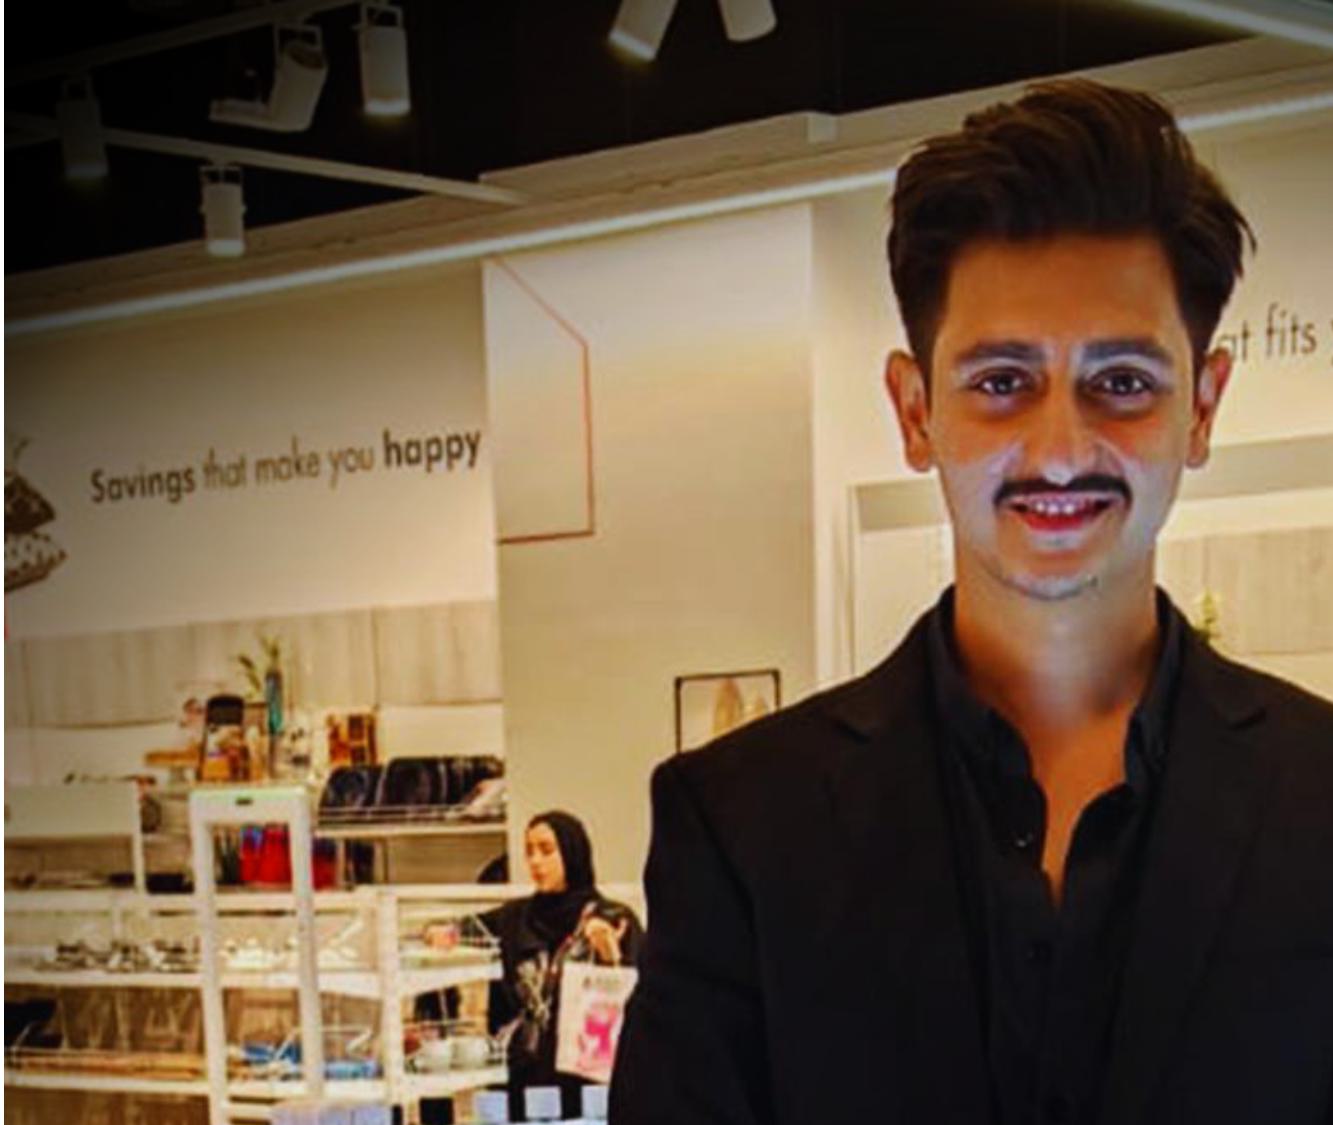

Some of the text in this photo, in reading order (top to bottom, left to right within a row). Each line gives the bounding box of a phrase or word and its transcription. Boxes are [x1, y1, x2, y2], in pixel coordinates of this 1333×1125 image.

[1266, 302, 1318, 358] fits
[90, 427, 483, 502] Savings that make you happy
